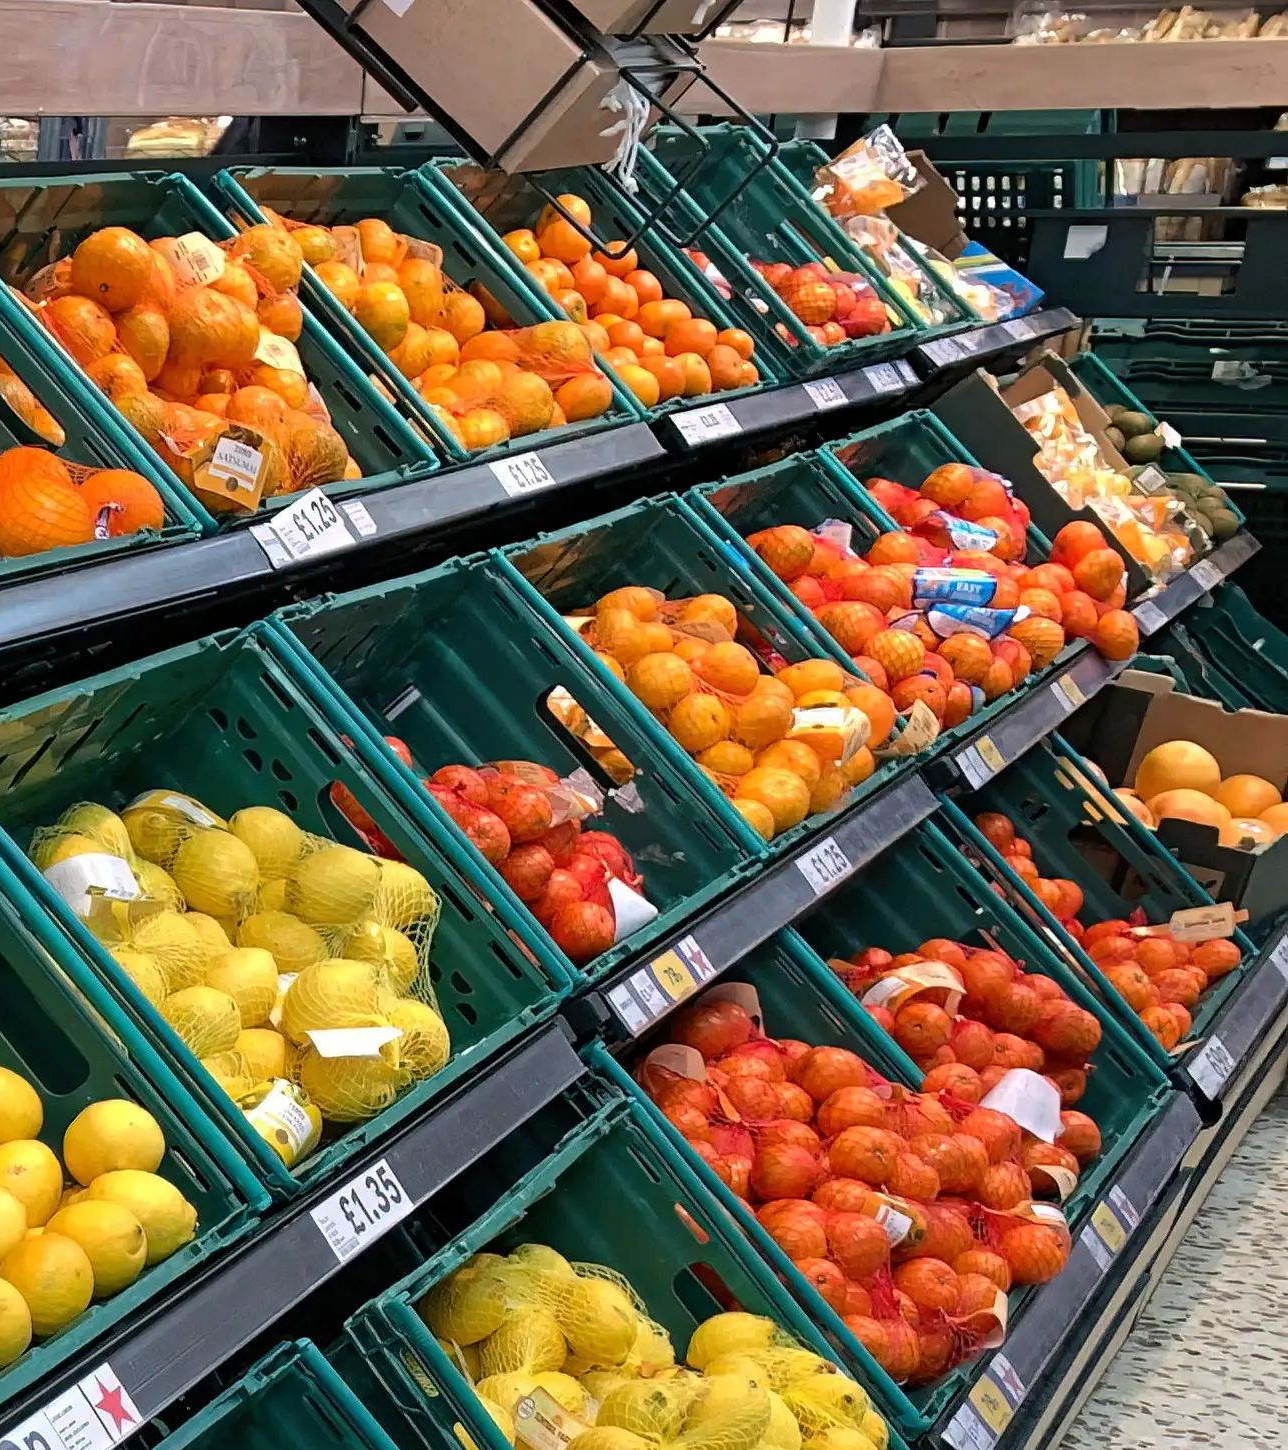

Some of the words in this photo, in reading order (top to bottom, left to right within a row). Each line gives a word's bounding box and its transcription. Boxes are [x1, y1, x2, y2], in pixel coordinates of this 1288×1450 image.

[508, 458, 549, 488] £1.25
[292, 496, 337, 541] £1.25
[811, 844, 847, 882] £1.25
[339, 1166, 402, 1235] £1.35
